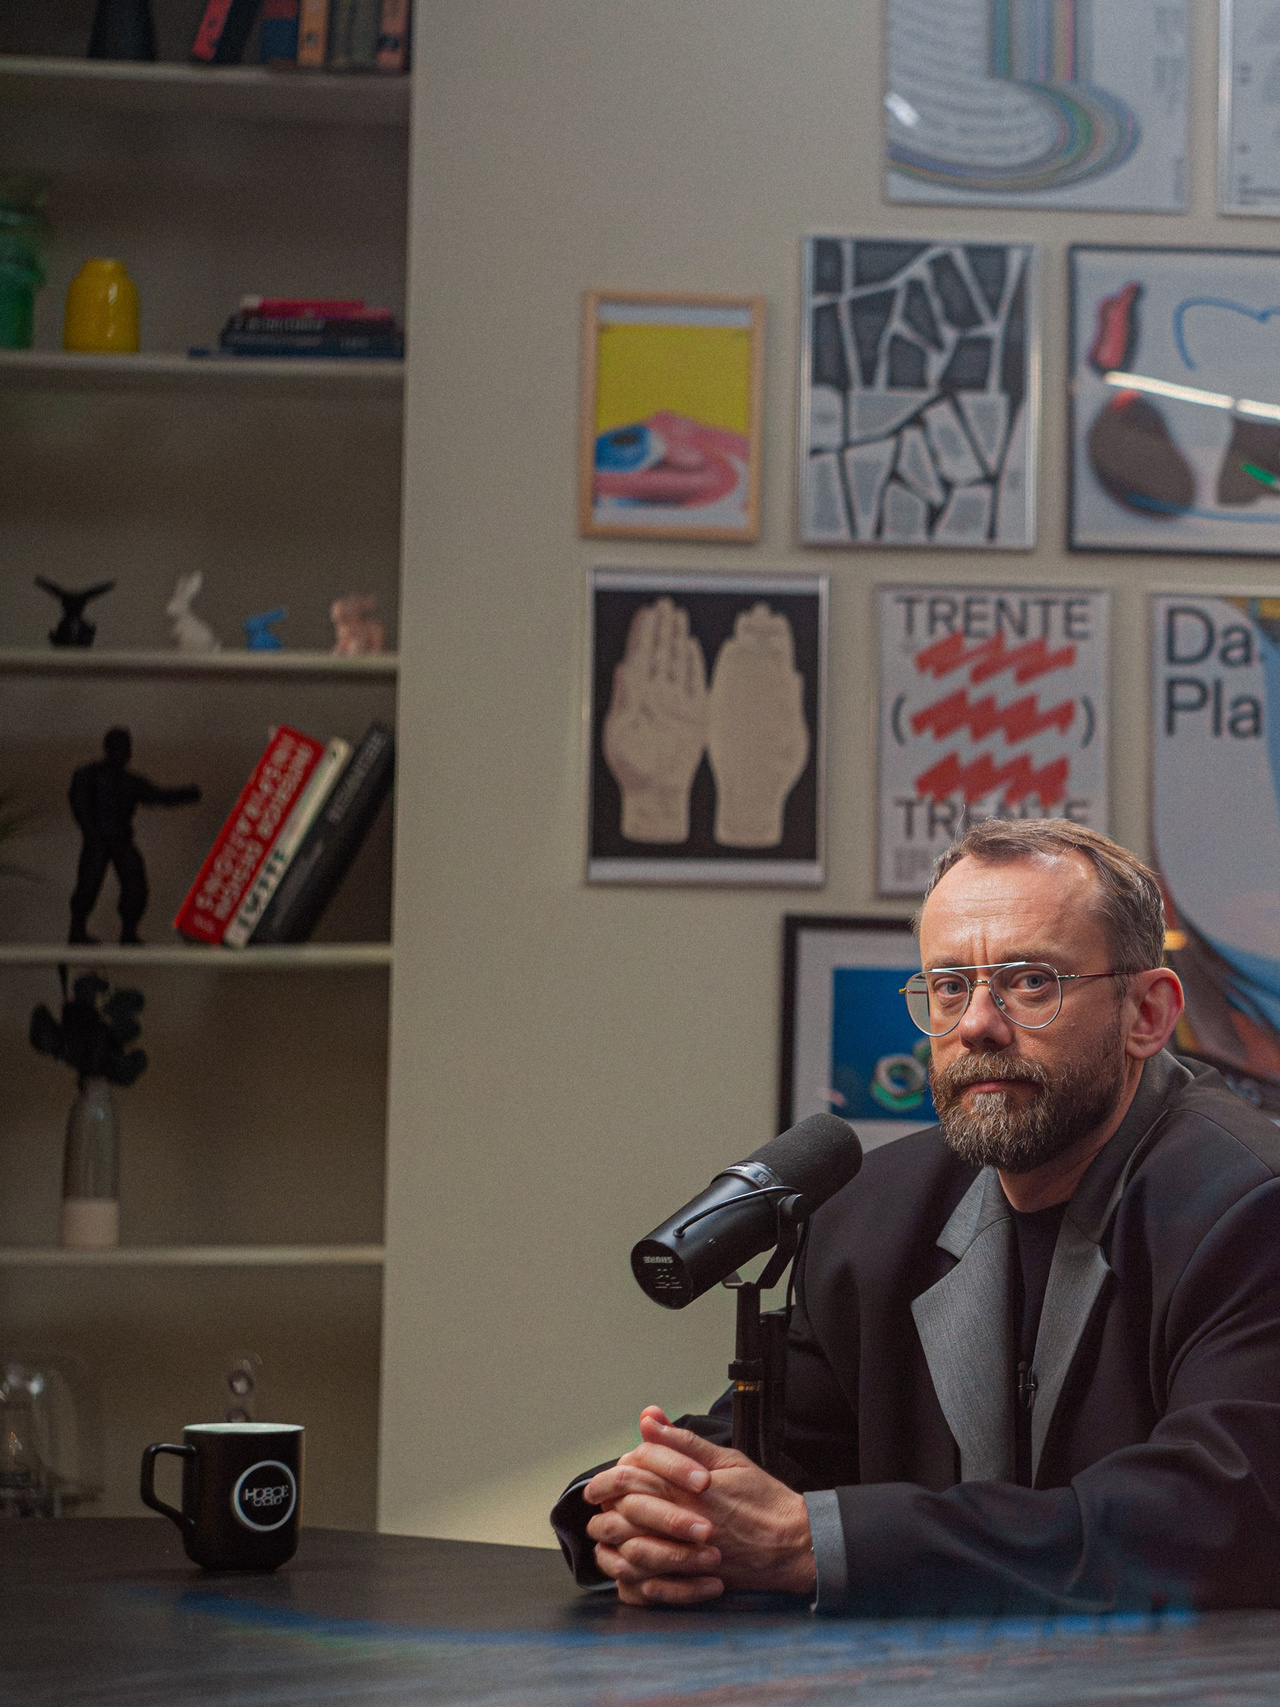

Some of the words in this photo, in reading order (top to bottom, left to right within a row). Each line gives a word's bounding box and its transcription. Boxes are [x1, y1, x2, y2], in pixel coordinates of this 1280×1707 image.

[895, 597, 1090, 639] TRENTE
[1166, 607, 1266, 668] Da
[1166, 677, 1262, 739] Pla
